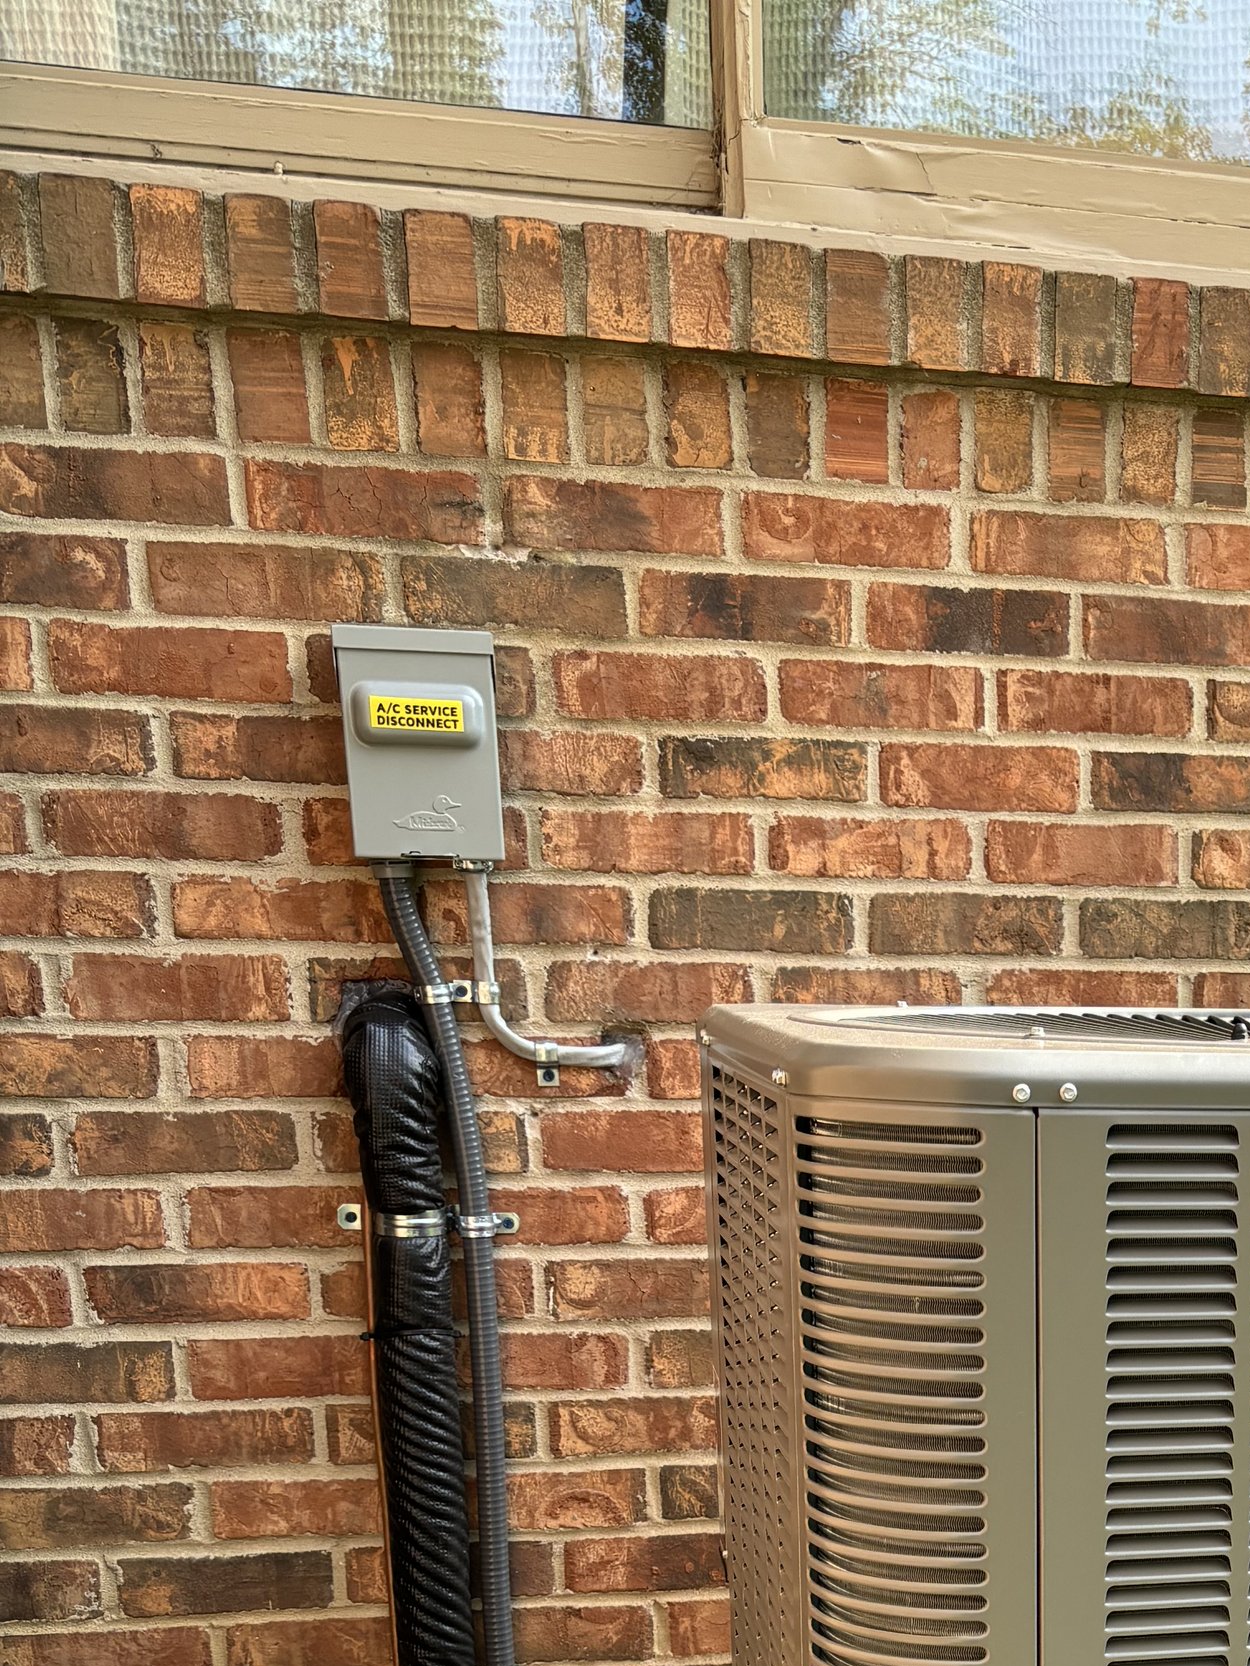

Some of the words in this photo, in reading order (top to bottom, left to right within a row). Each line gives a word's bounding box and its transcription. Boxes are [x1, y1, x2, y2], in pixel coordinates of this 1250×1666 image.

[377, 702, 400, 714] A/C
[404, 704, 458, 717] SERVICE
[377, 715, 459, 729] DISCONNECT
